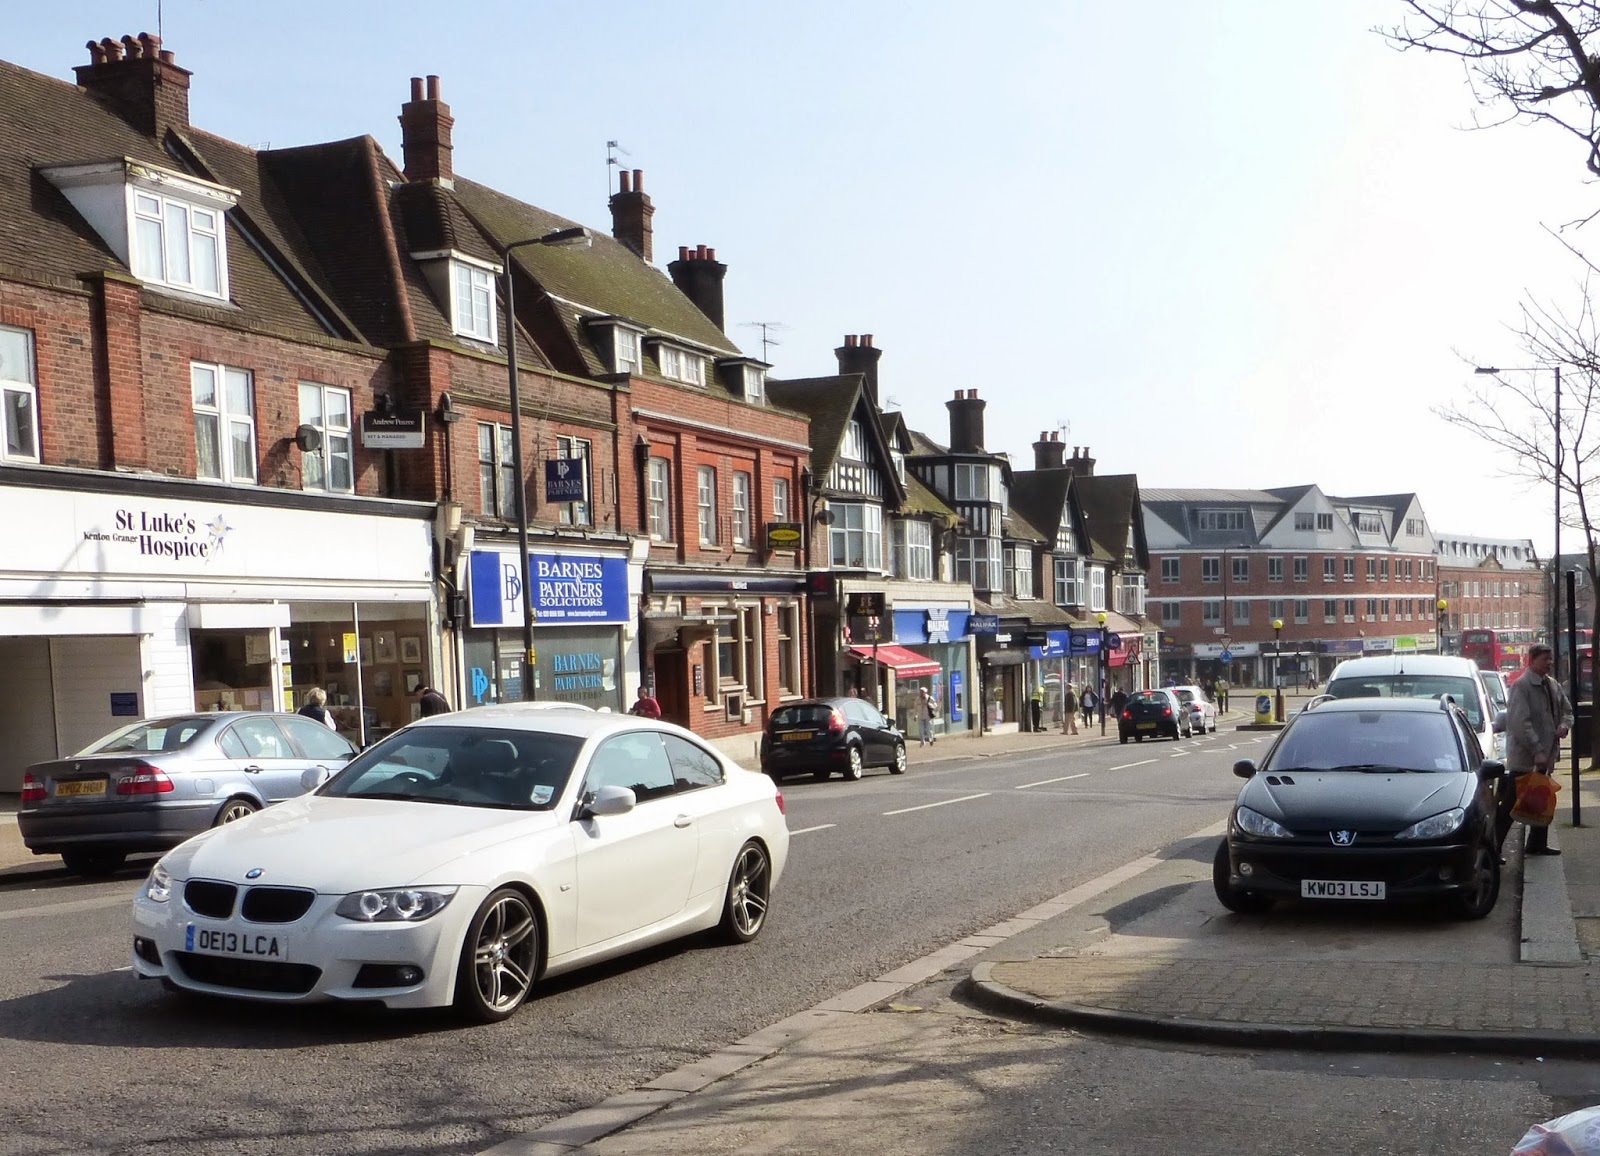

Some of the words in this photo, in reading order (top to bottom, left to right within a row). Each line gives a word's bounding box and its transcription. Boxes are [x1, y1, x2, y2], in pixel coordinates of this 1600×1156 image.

[547, 480, 582, 488] BARNES
[115, 509, 135, 531] St
[140, 511, 196, 534] Luke's
[83, 531, 111, 542] Kenton
[112, 532, 138, 543] Grange
[138, 534, 209, 561] Hospice
[537, 561, 603, 579] BARNES
[538, 581, 604, 598] PARTNERS
[539, 598, 604, 607] SOLICITORS
[553, 653, 601, 673] BARNES
[554, 675, 602, 691] PARTNERS
[554, 691, 602, 701] SOLICITORS
[1307, 881, 1346, 896] KW03
[1349, 883, 1379, 897] LSJ
[199, 930, 238, 952] OE13
[242, 934, 280, 957] LCA
